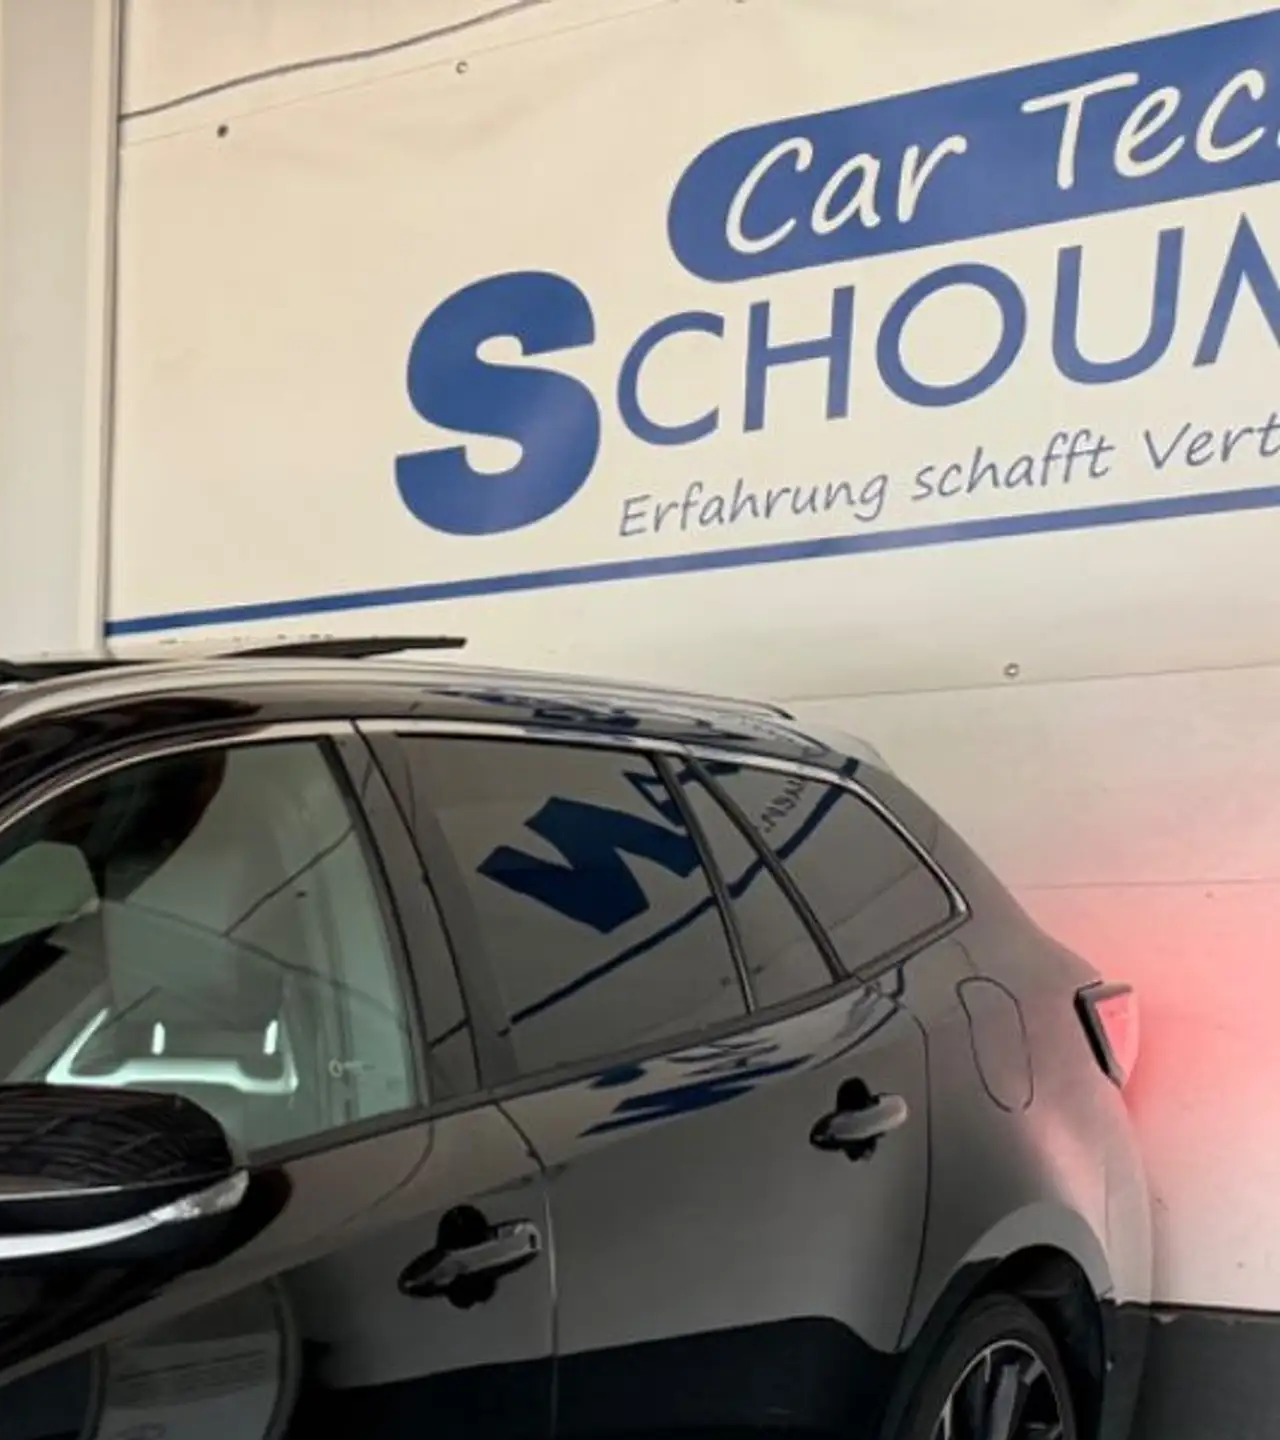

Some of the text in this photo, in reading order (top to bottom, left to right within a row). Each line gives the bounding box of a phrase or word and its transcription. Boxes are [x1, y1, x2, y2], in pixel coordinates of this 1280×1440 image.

[724, 68, 1280, 256] Car Tec
[618, 472, 889, 538] Erfahrung
[910, 428, 1116, 506] schafft
